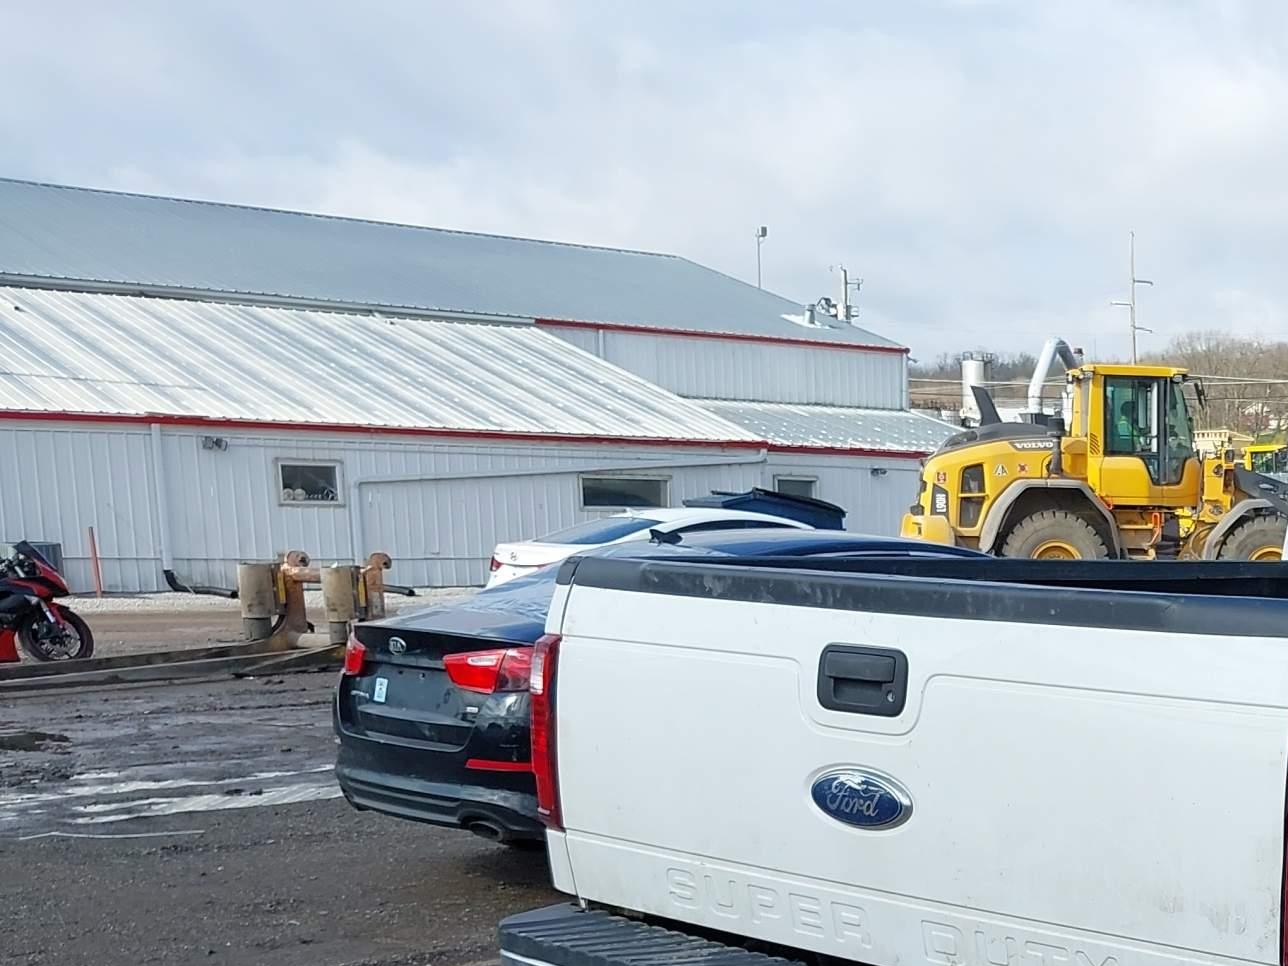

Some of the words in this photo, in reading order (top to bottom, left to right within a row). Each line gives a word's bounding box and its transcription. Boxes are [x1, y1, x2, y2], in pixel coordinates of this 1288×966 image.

[1013, 441, 1054, 449] VOLVO
[935, 493, 947, 513] L90H
[826, 776, 885, 817] Ford
[665, 866, 873, 950] SUPER
